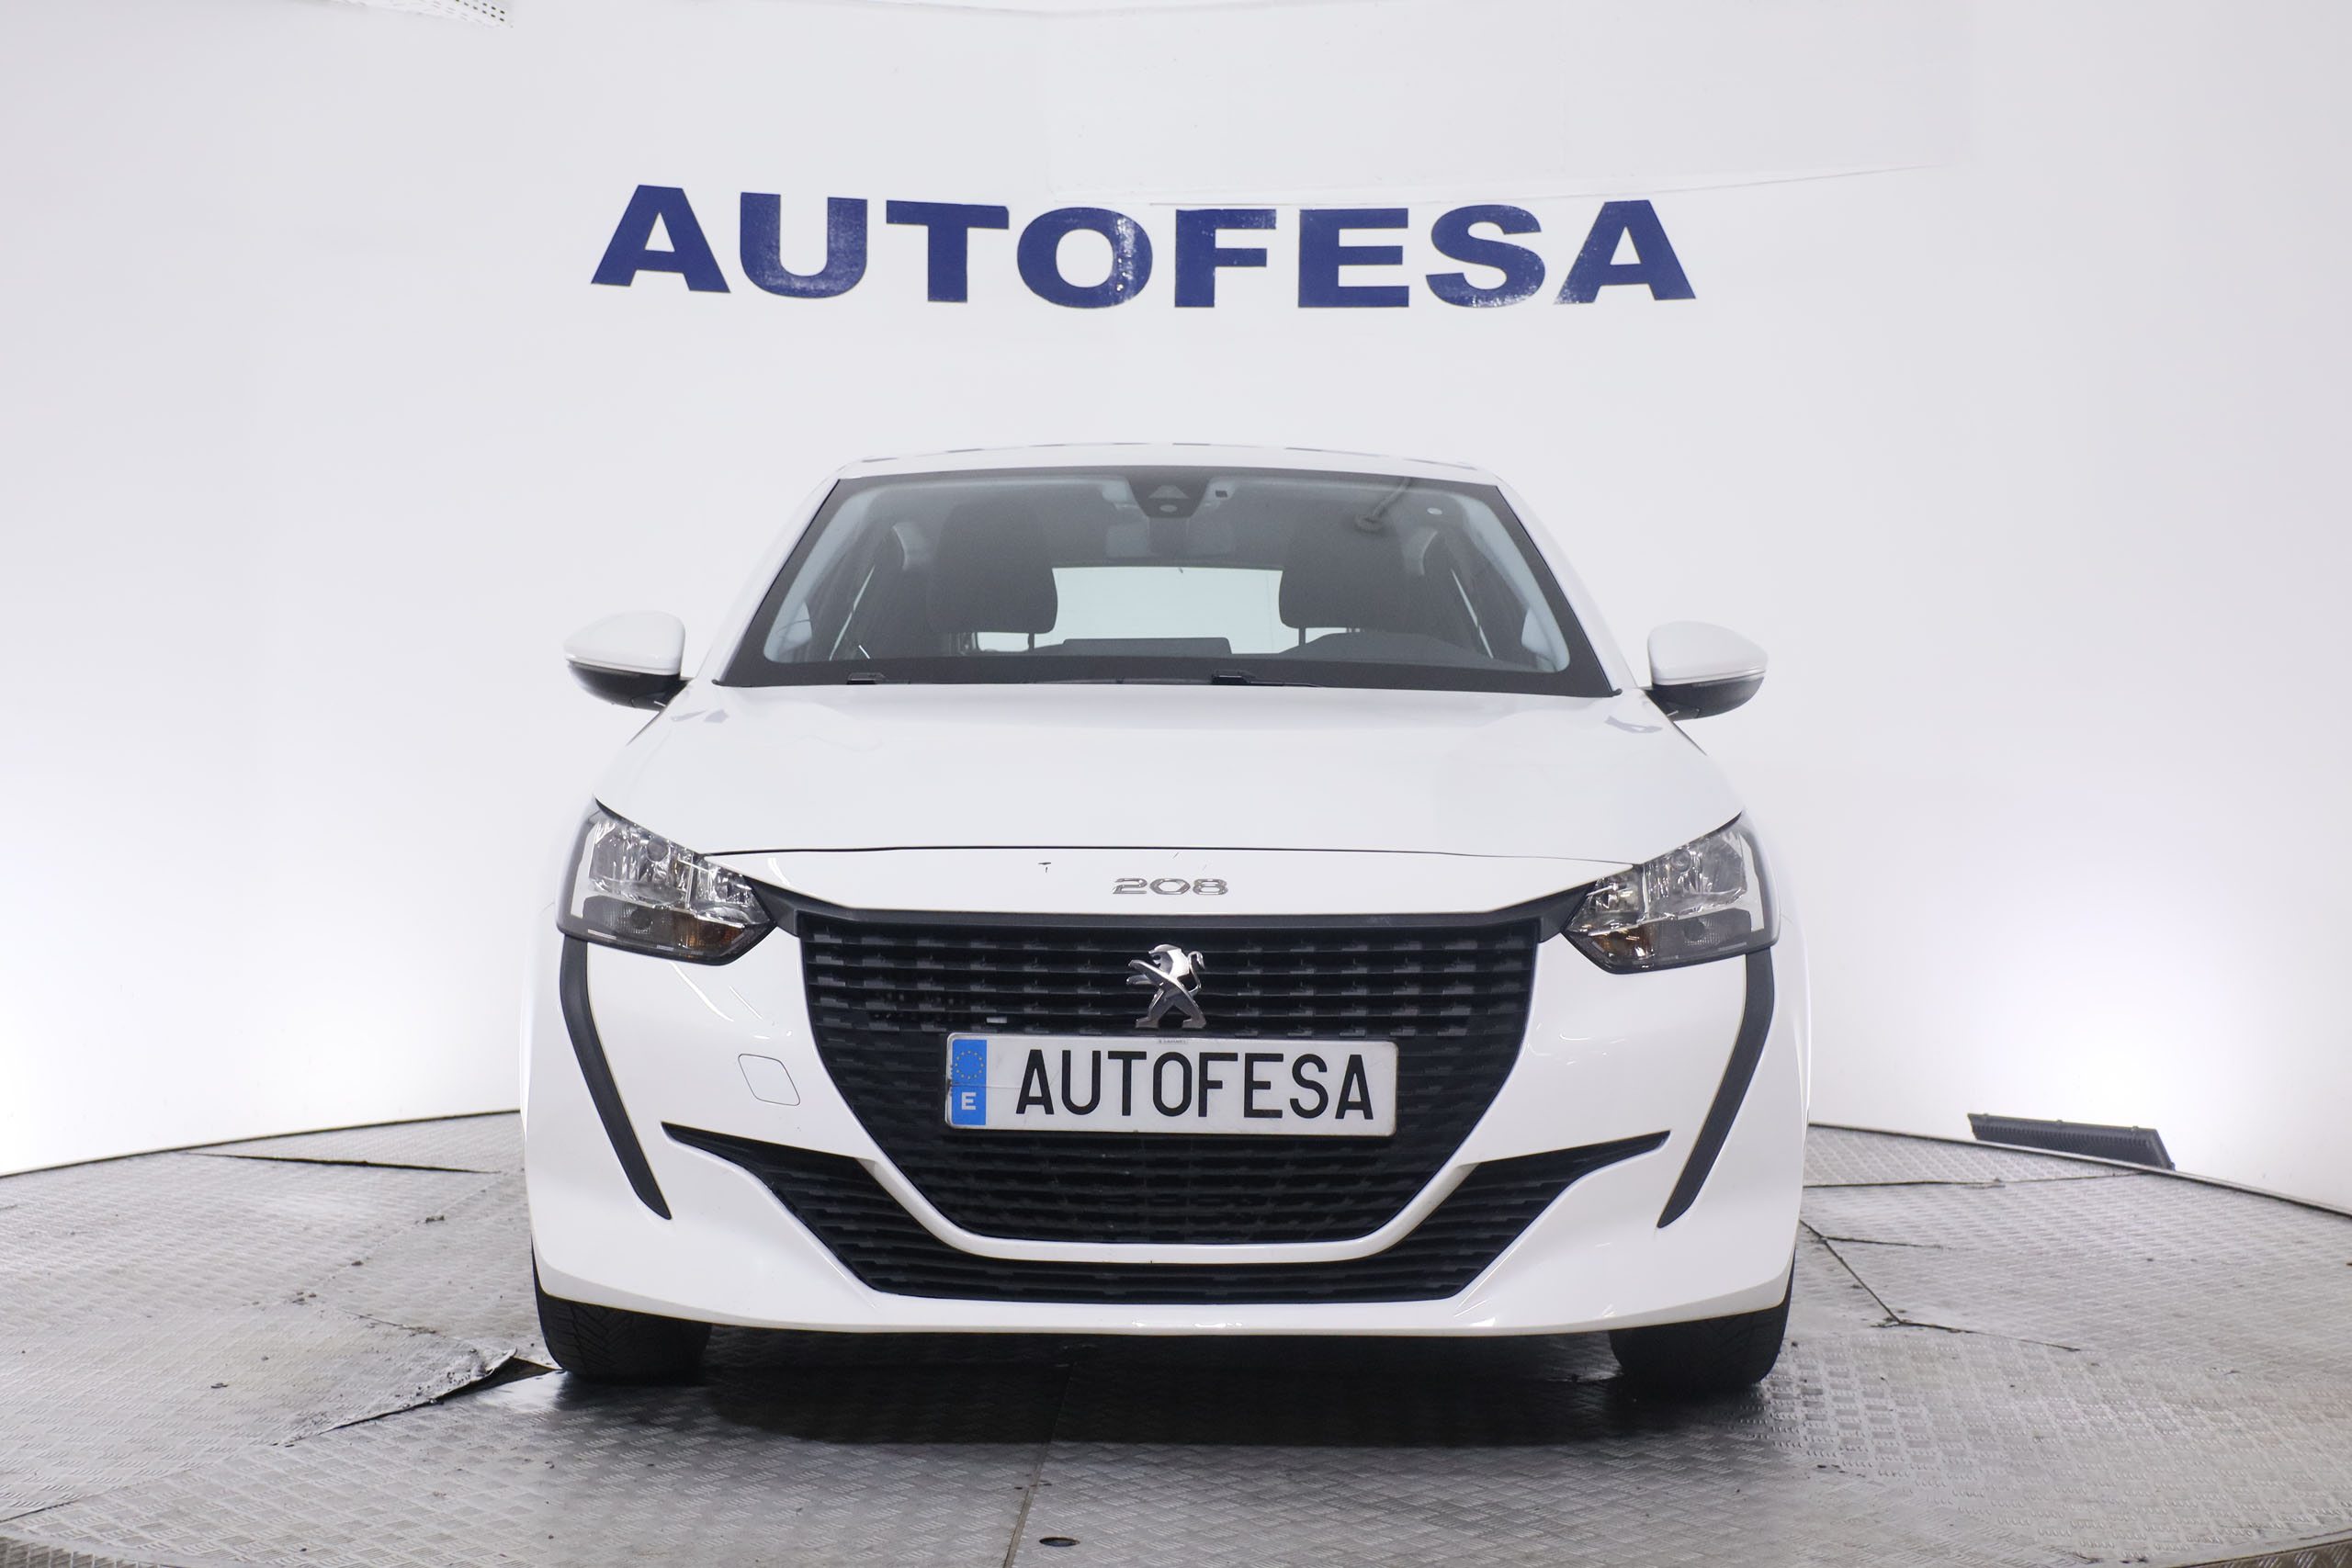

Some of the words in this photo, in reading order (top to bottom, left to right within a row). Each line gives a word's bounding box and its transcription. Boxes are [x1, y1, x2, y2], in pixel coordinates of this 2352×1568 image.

[592, 184, 1697, 308] AUTOFESA
[1112, 877, 1229, 897] 208
[961, 1091, 977, 1111] E
[1015, 1049, 1374, 1121] AUTOFESA
